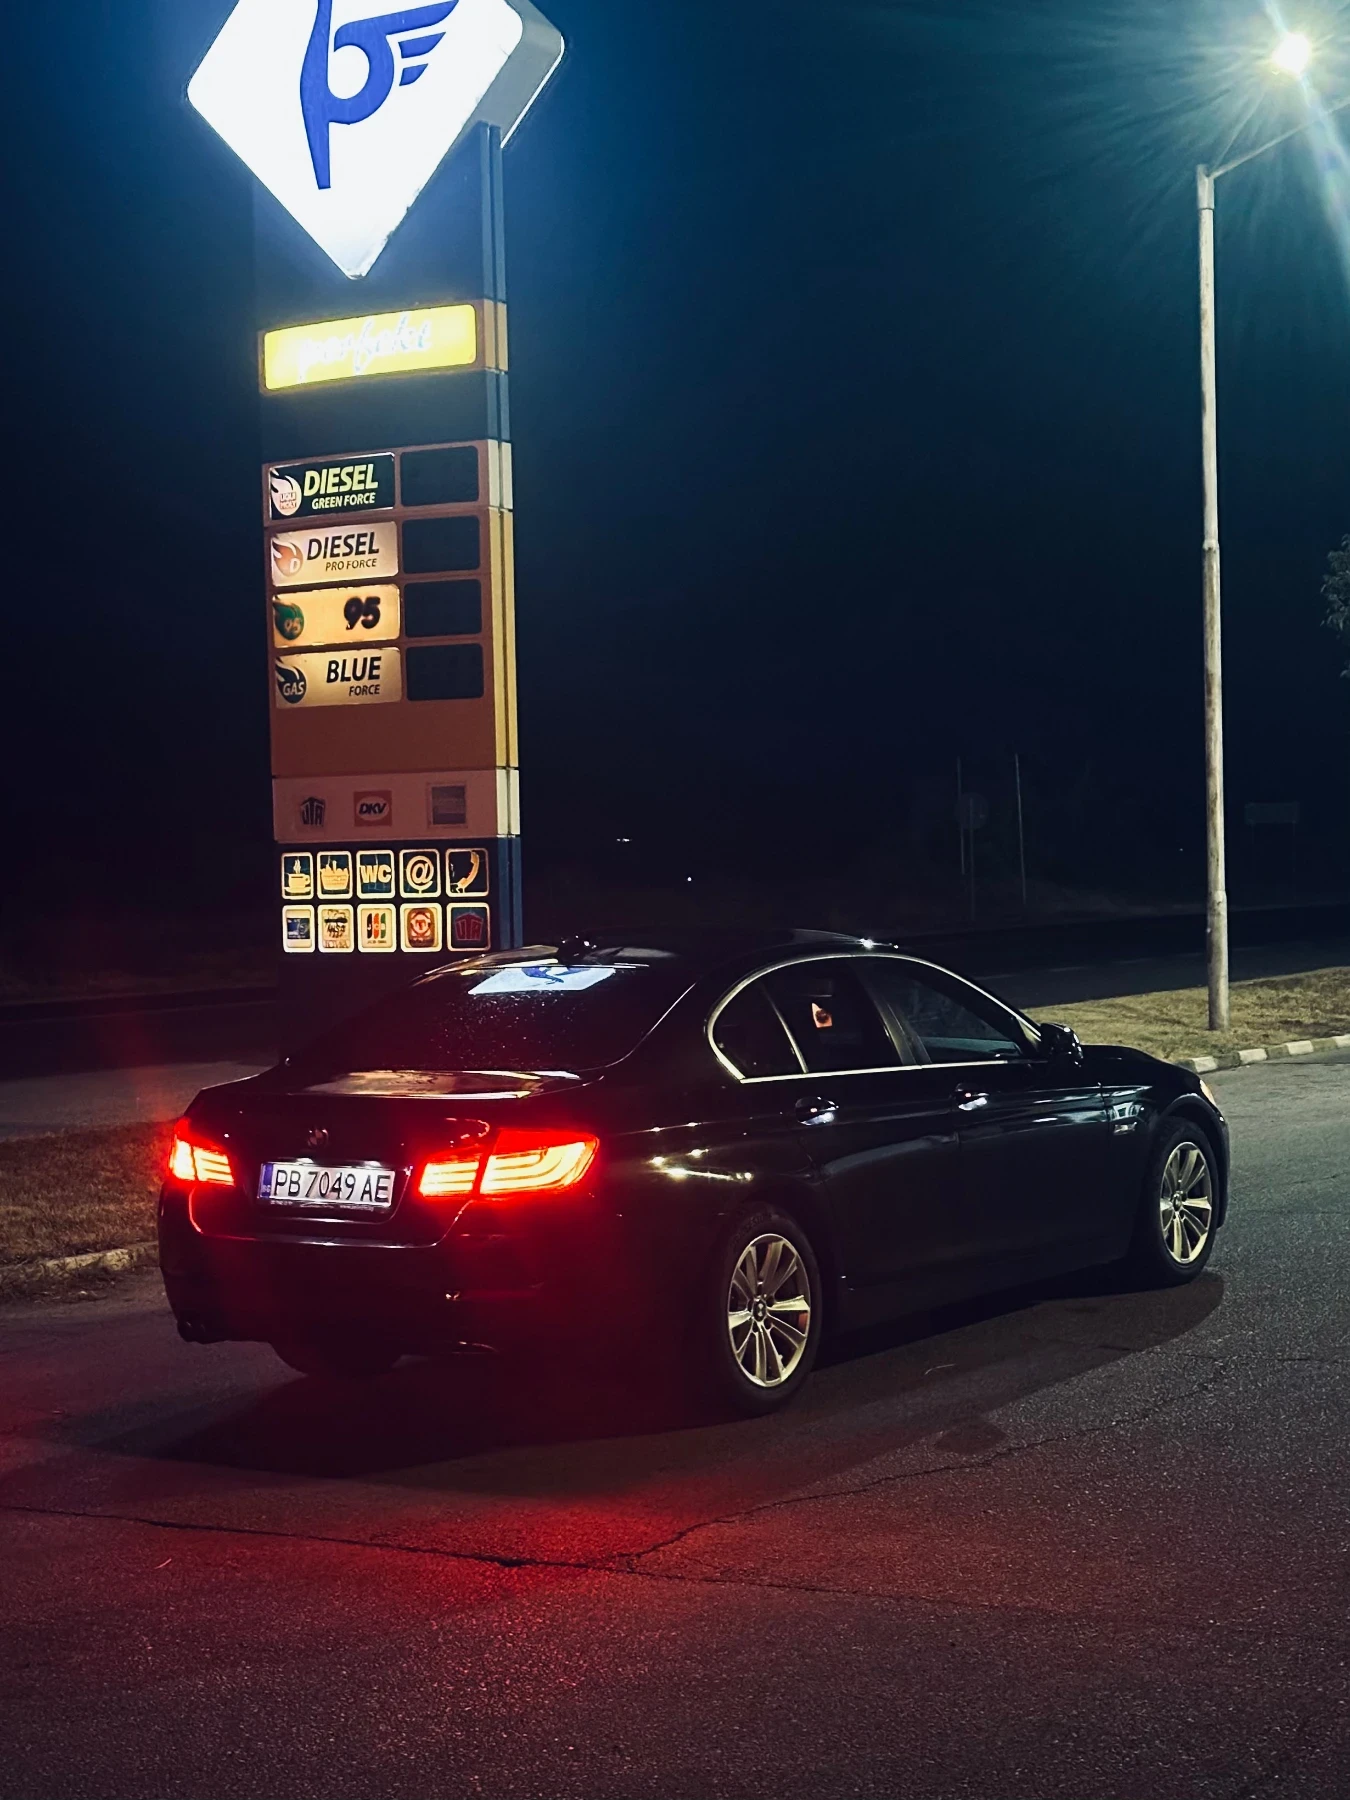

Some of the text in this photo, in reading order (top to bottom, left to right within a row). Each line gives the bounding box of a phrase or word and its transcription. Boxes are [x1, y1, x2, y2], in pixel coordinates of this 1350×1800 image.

[303, 463, 379, 497] DIESEL
[311, 491, 376, 510] GREEN FORCE
[306, 531, 380, 560] DIESEL
[325, 558, 377, 572] PRO FORCE
[343, 596, 381, 630] 95
[326, 656, 382, 684] BLUE
[282, 681, 305, 696] GAS
[348, 684, 380, 697] FORCE
[358, 802, 388, 815] DKV
[359, 864, 392, 884] WC
[274, 1169, 391, 1203] PB 7049 AE
